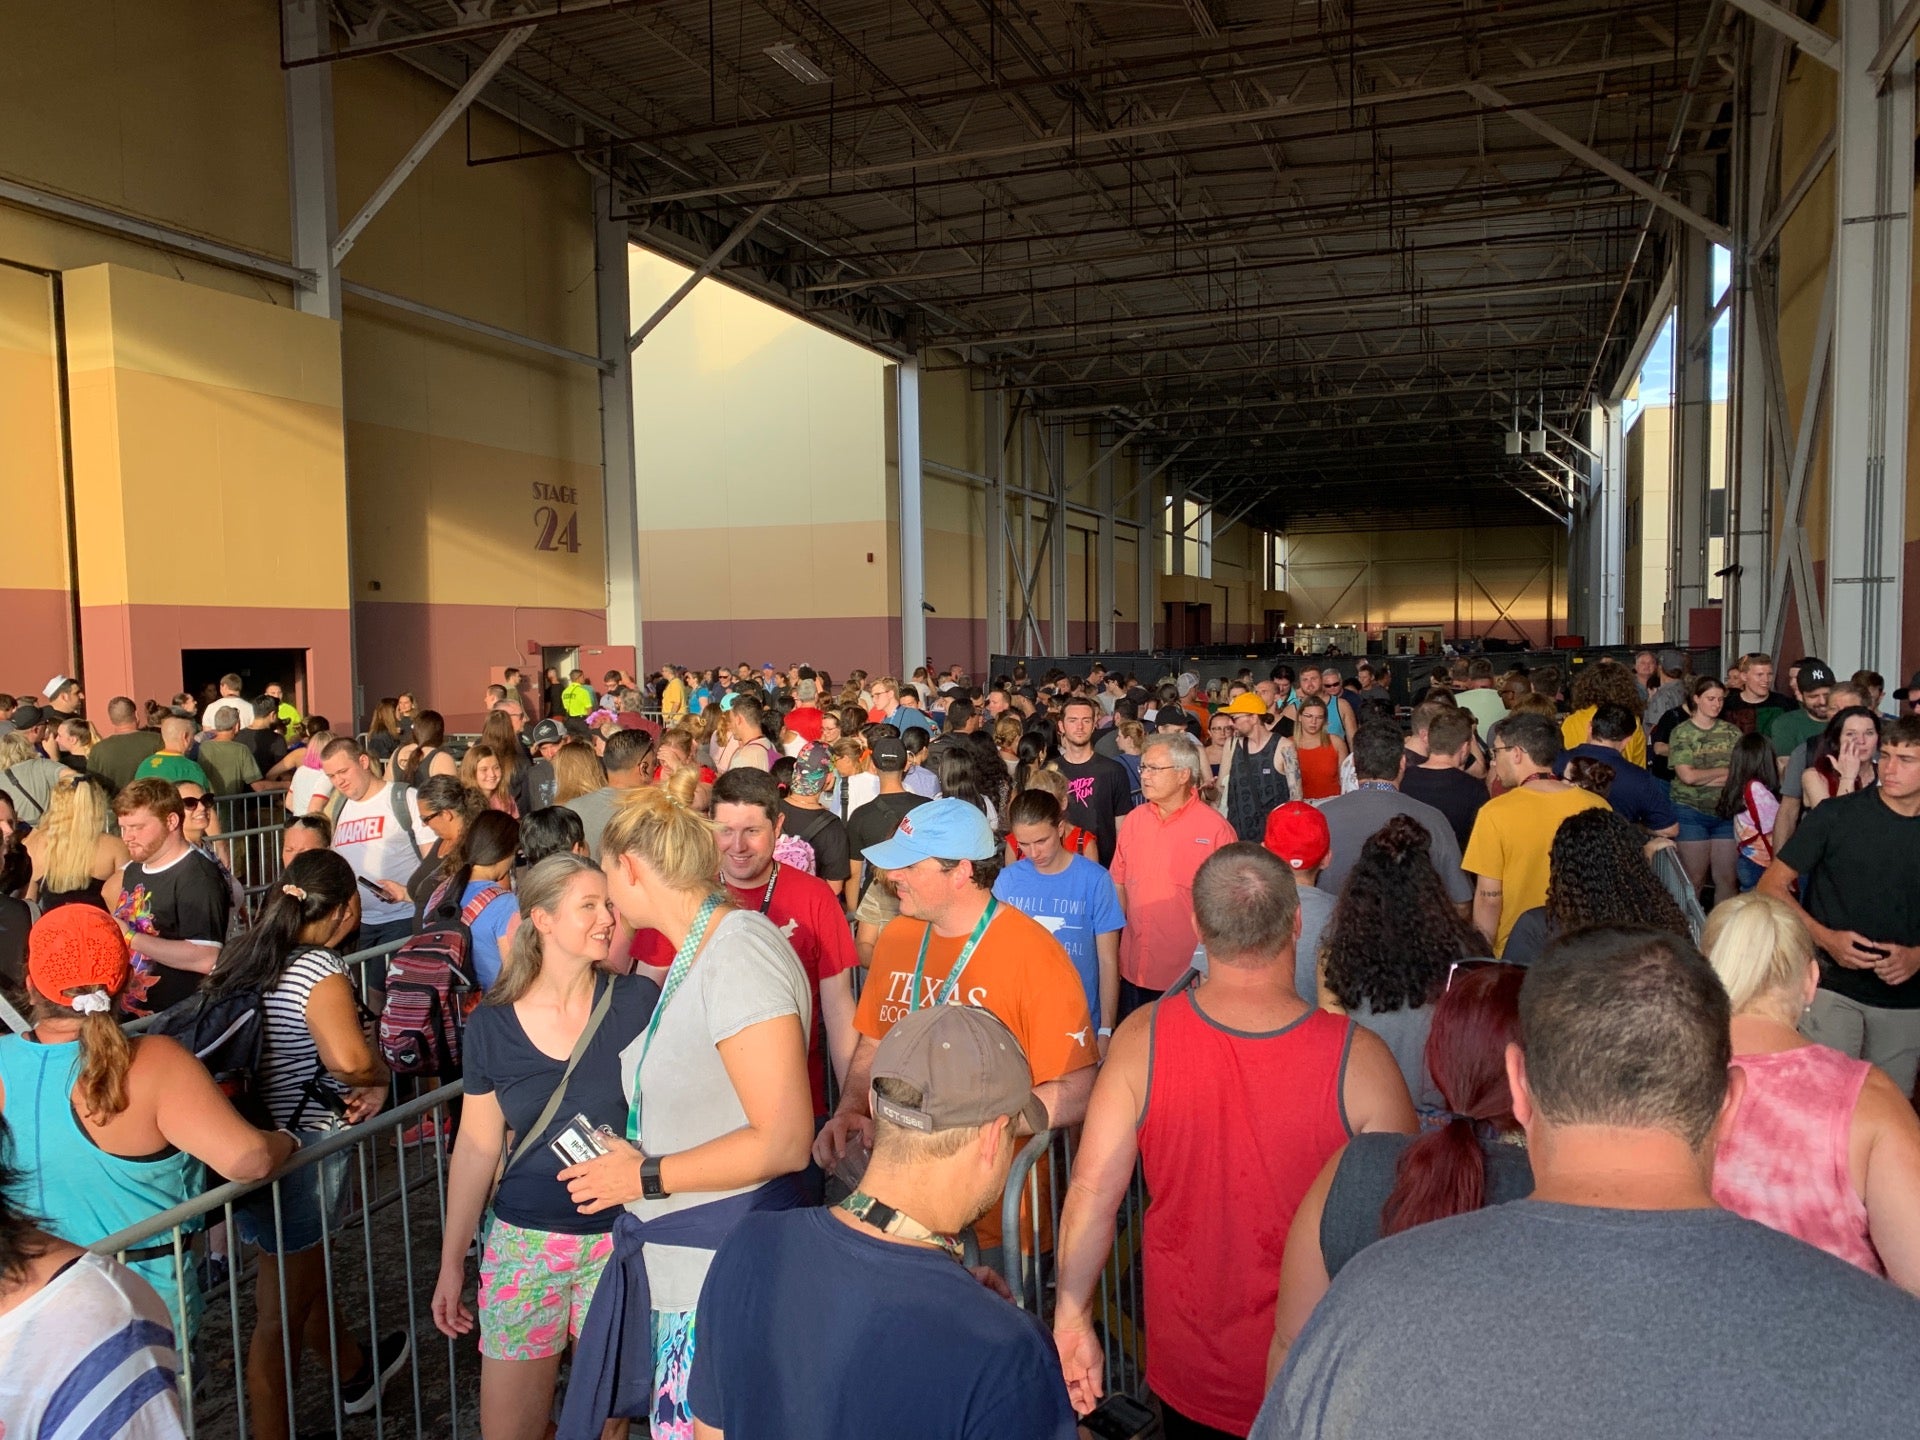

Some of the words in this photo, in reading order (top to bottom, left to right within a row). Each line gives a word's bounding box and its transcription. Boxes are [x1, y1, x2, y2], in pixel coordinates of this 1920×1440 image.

[532, 481, 578, 505] STAGE
[534, 506, 582, 553] 24
[1067, 787, 1093, 808] RUN
[334, 817, 382, 845] MARVEL
[1008, 896, 1044, 912] SMALL
[886, 971, 987, 1008] TEXAS
